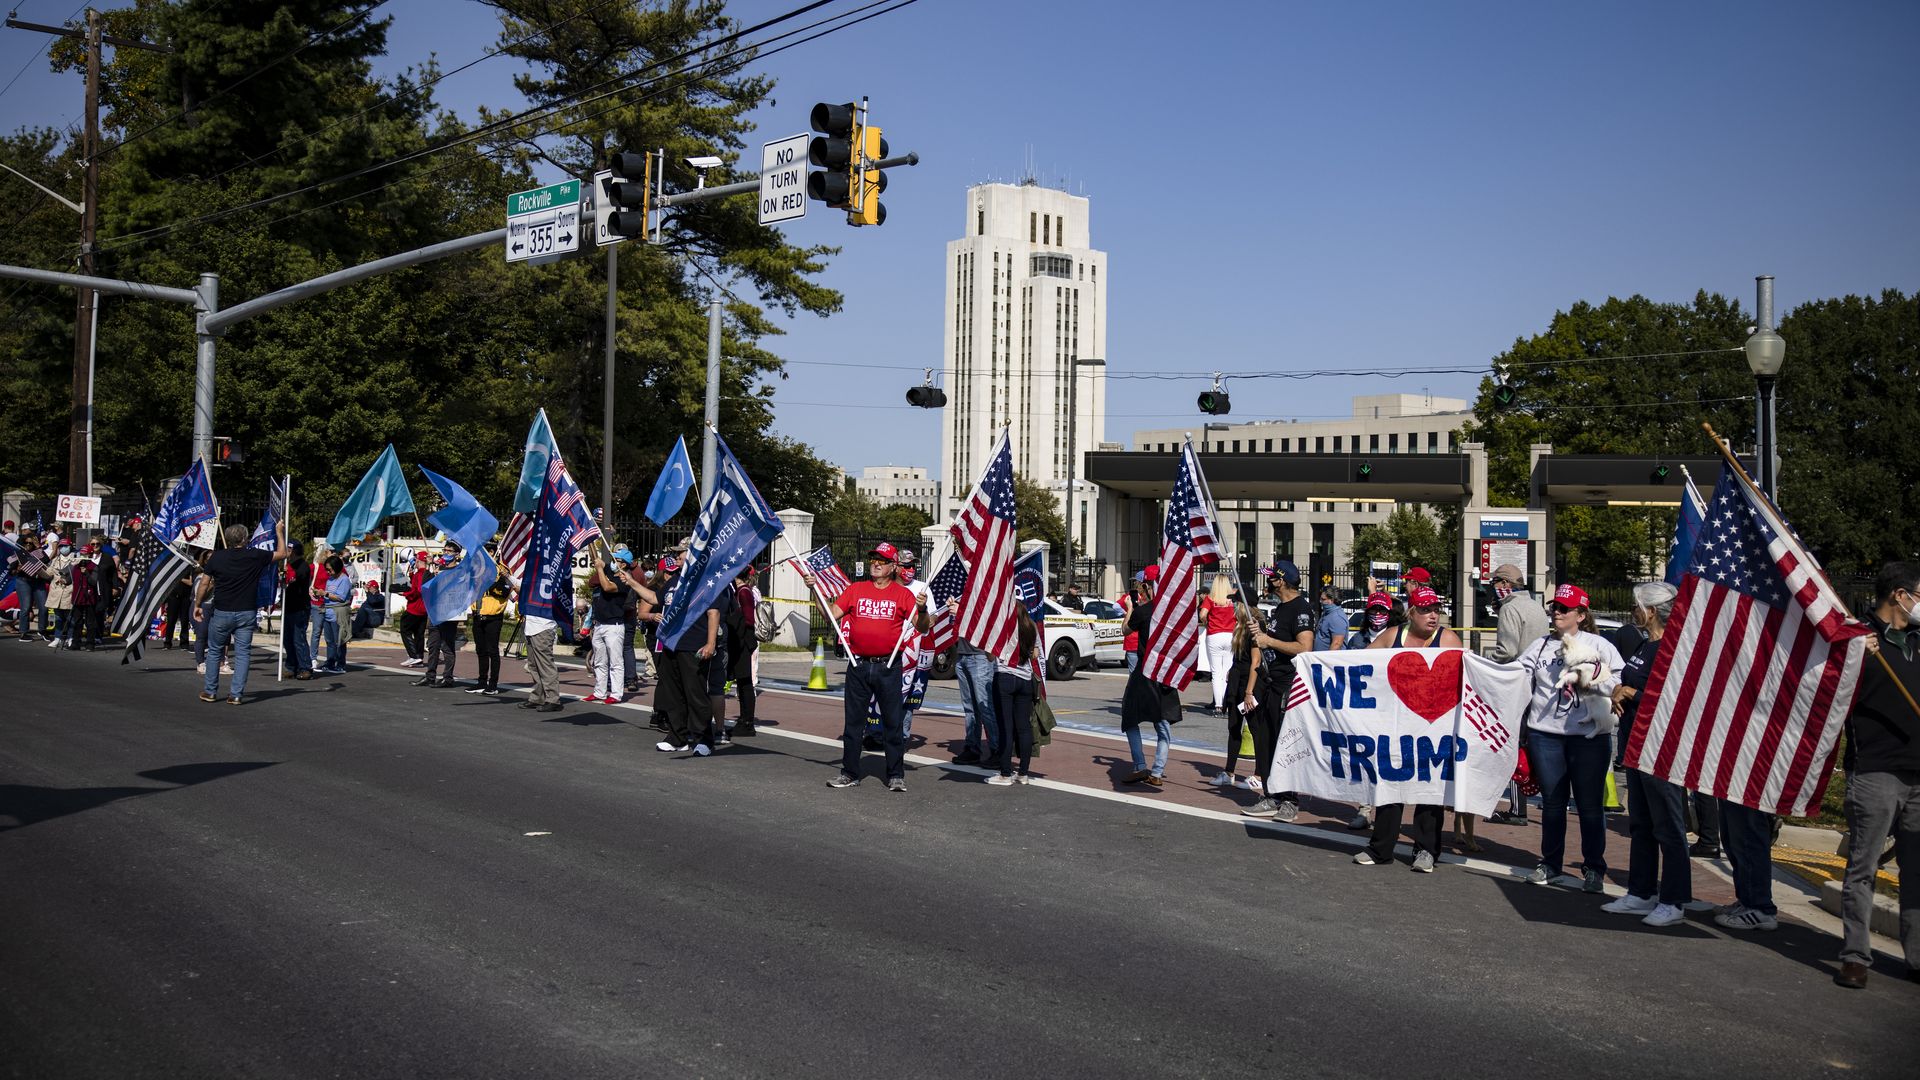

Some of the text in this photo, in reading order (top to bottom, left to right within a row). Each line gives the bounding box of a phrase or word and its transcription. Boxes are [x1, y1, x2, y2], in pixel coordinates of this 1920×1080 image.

[776, 148, 793, 166] NO
[770, 170, 798, 190] TURN
[518, 186, 571, 212] Rockville Pike
[763, 192, 803, 214] ON RED
[530, 226, 552, 254] 355
[60, 496, 98, 511] GET
[58, 510, 92, 520] WELL
[859, 600, 895, 608] TRUMP
[859, 606, 893, 615] PENCE
[1311, 664, 1376, 710] WE
[1320, 730, 1468, 784] TRUMP
